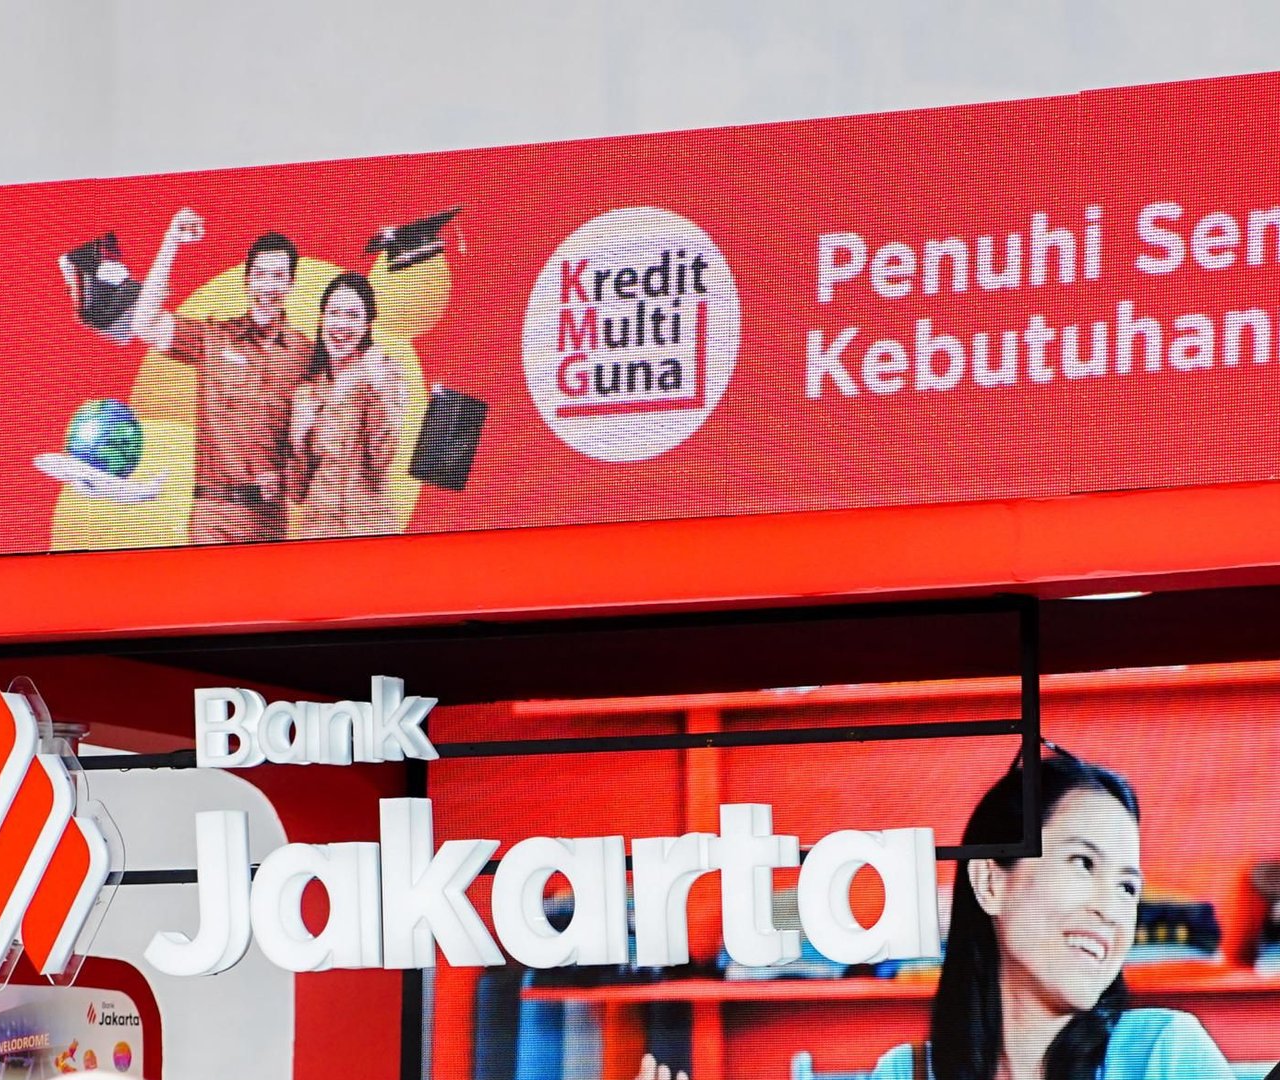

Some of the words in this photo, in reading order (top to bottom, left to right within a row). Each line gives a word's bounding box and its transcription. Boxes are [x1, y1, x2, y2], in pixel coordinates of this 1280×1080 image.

[560, 250, 708, 303] Kredit
[817, 206, 1103, 302] Penuhi
[557, 300, 682, 352] Multi
[556, 352, 683, 396] Guna
[195, 674, 439, 767] Bank
[145, 798, 940, 976] Jakarta
[98, 1012, 140, 1026] Jakarta
